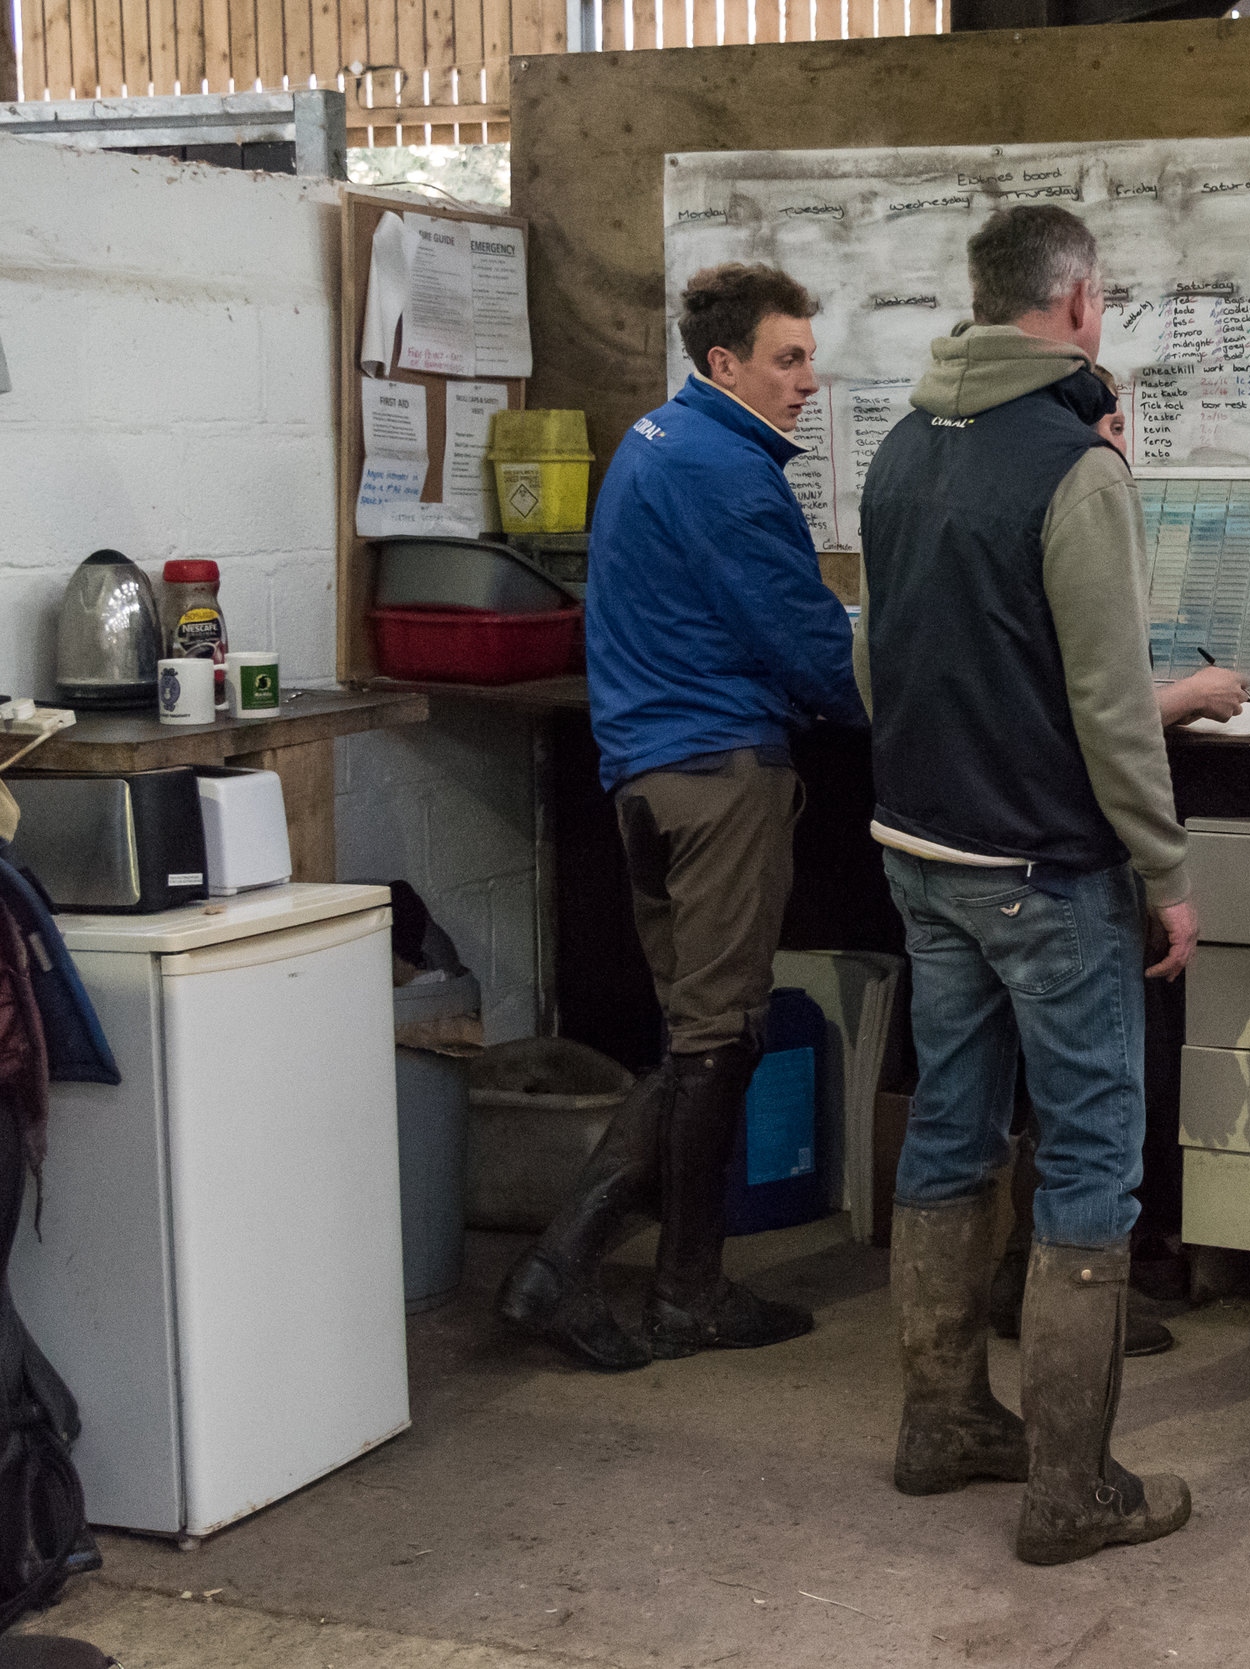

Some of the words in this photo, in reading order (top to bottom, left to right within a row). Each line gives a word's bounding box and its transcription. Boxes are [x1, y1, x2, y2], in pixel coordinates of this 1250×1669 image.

[778, 203, 845, 220] Tuesday
[471, 240, 516, 255] EMERGENCY
[1176, 281, 1234, 294] Saturday
